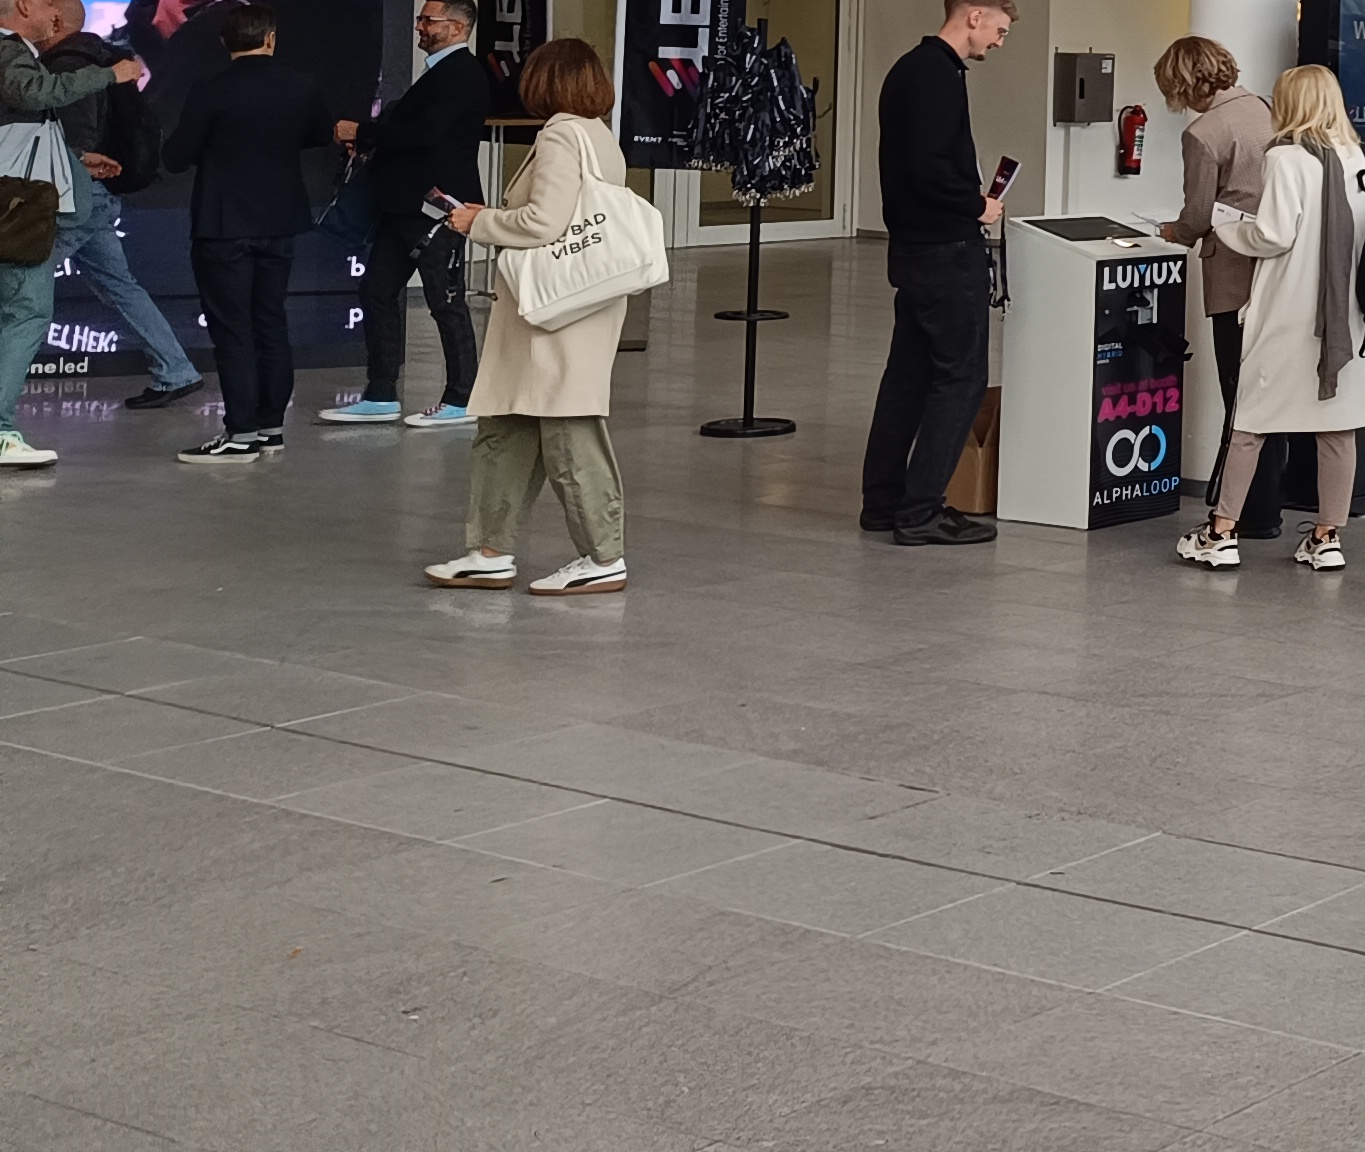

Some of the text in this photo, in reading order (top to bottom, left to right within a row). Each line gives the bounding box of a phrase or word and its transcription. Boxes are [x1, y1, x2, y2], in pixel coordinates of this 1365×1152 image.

[570, 212, 607, 236] BAD
[551, 232, 602, 260] VIBES
[1097, 387, 1180, 424] A4-D12
[1092, 476, 1180, 507] ALPHALOOP
